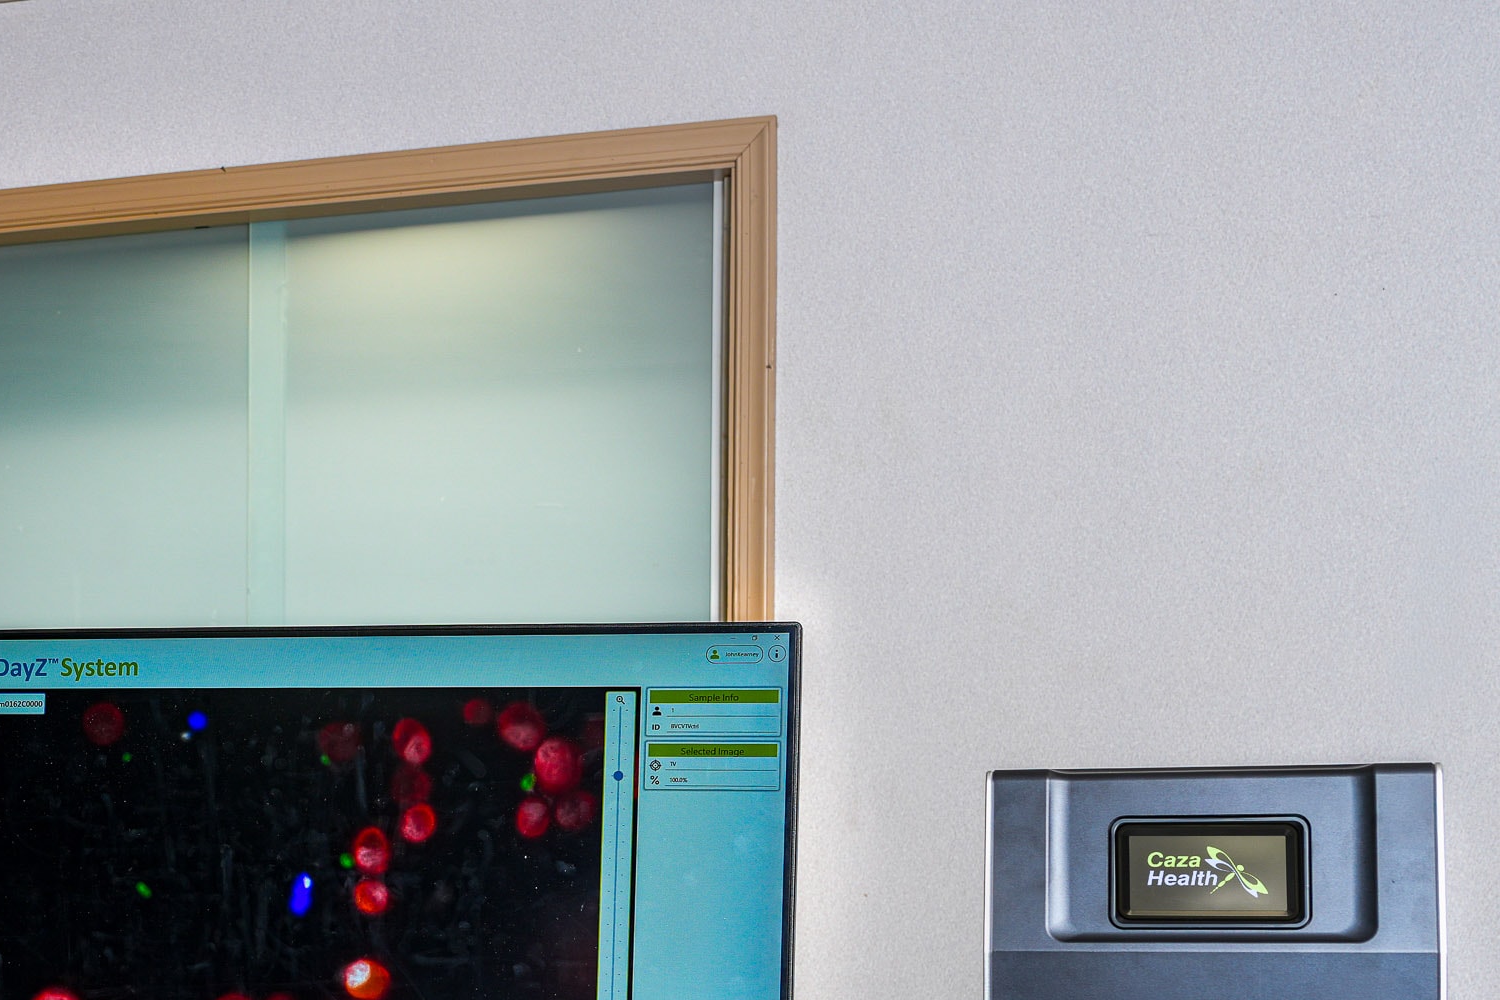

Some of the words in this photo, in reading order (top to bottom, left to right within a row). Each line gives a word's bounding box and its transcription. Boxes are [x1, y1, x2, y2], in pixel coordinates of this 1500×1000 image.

[61, 658, 138, 681] System
[689, 694, 720, 703] Sample
[718, 748, 745, 757] Image
[1147, 851, 1202, 868] Caza
[1147, 870, 1218, 887] Health
